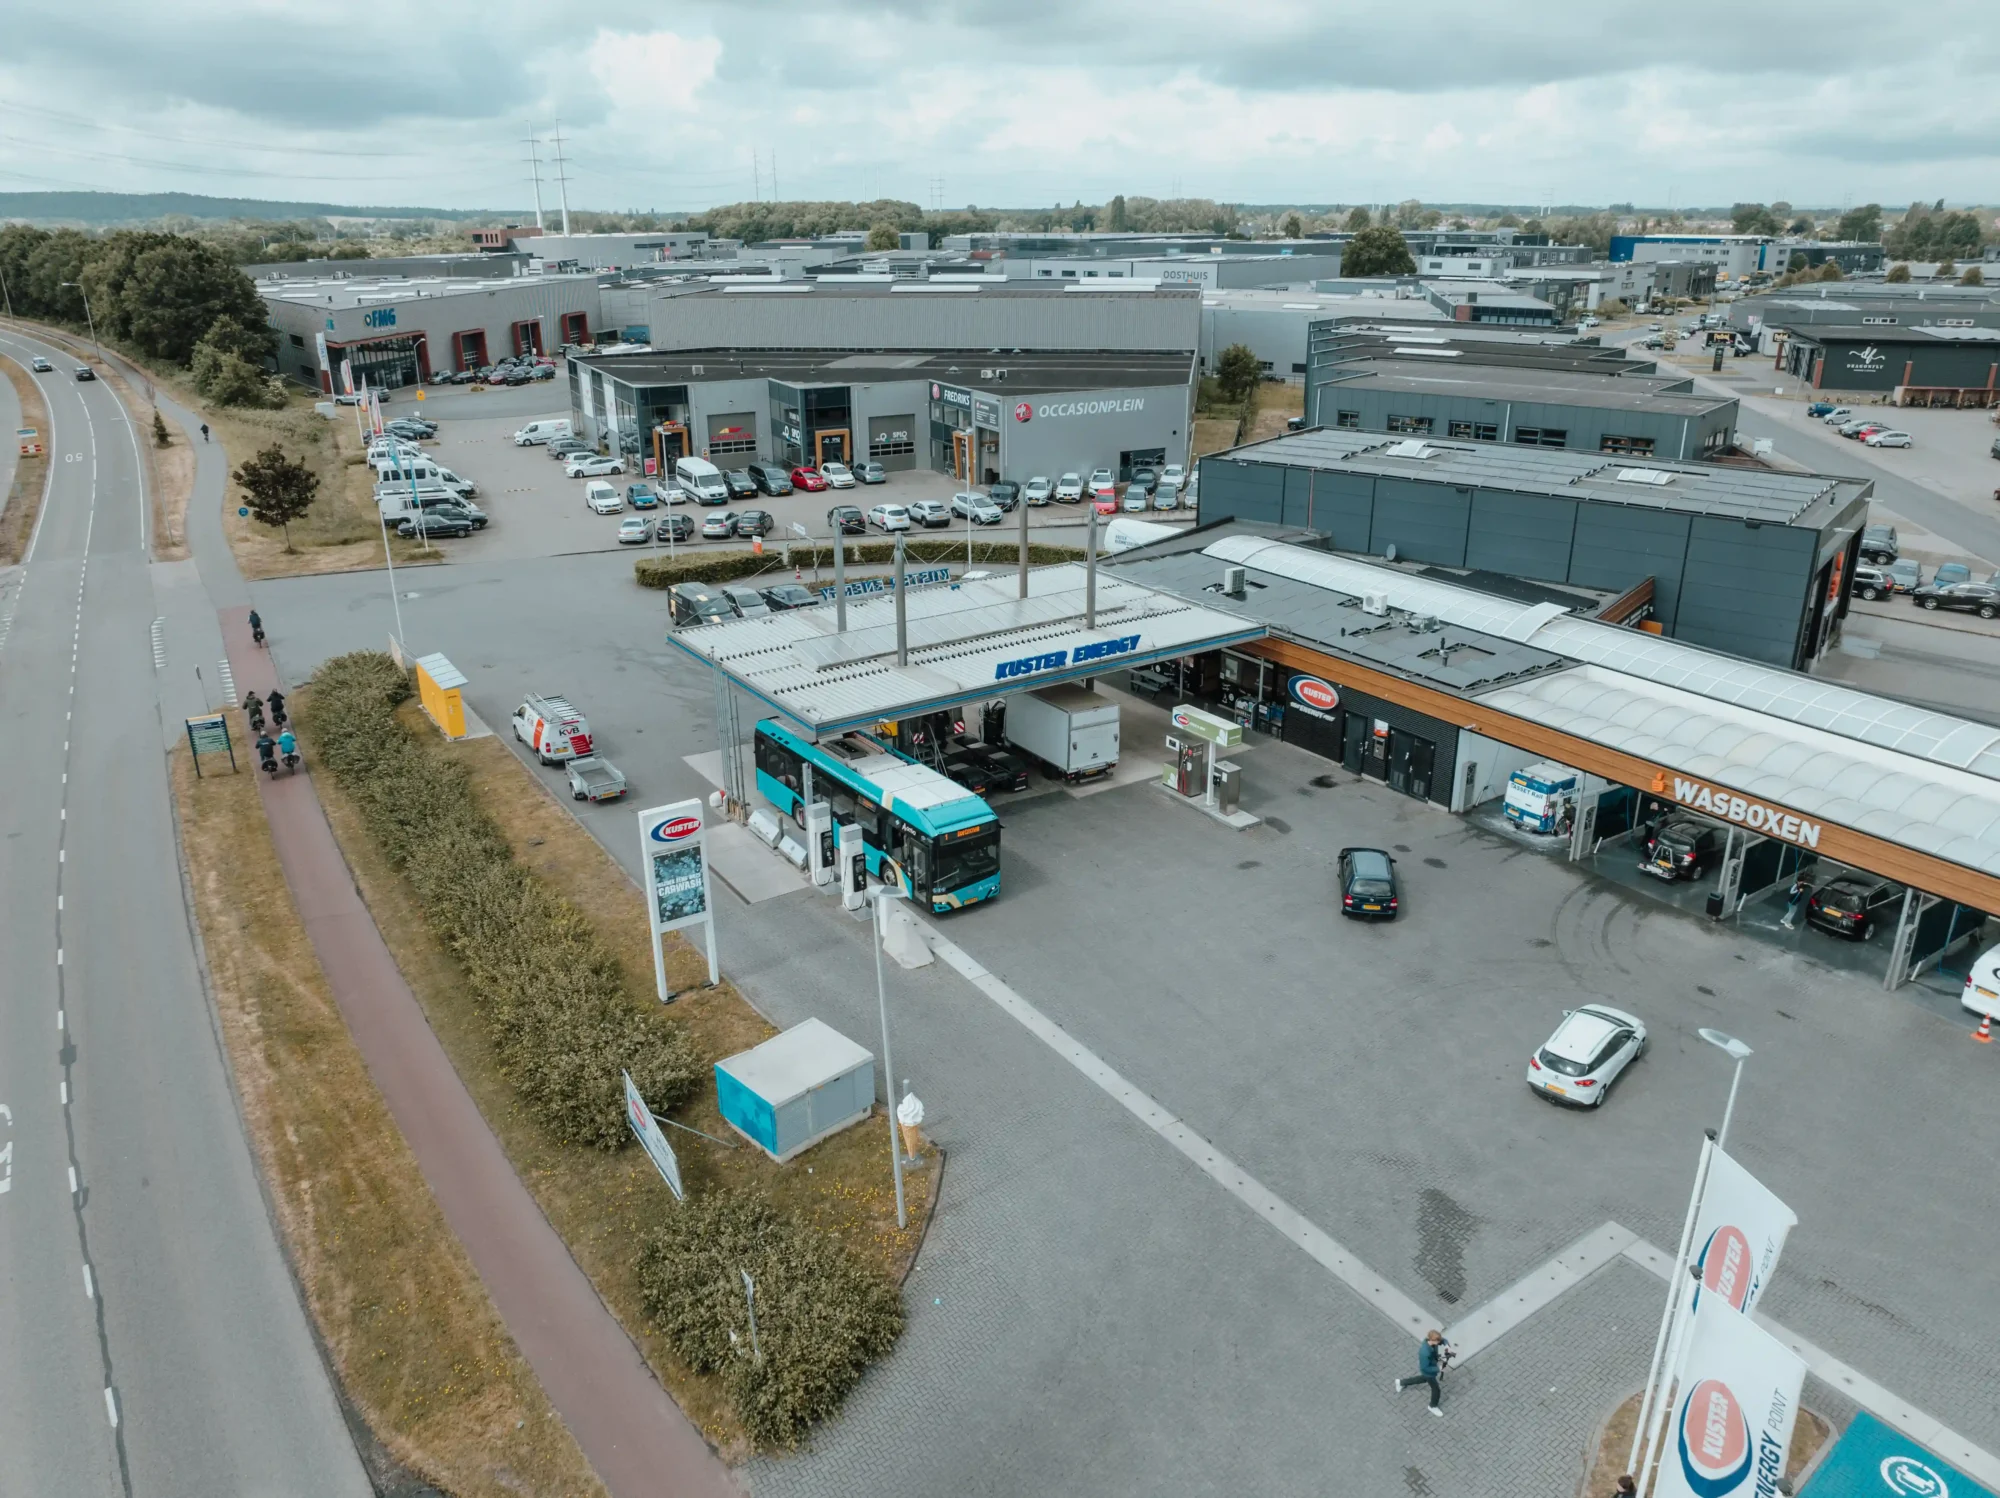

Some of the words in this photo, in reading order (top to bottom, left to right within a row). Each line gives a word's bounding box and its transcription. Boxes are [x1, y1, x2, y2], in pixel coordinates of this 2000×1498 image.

[1163, 270, 1209, 280] OOSTHUIS
[371, 308, 397, 328] FMG
[944, 389, 971, 406] FREDRIKS
[1039, 398, 1145, 418] OCCASIONPLEIN
[65, 452, 83, 463] 50
[995, 650, 1068, 680] KUSTER
[1072, 634, 1141, 664] ENERGY
[1303, 686, 1332, 703] KUSTER
[559, 726, 580, 737] KVB
[1674, 777, 1821, 848] WASBOXEN
[665, 820, 700, 835] KUSTER
[658, 877, 702, 897] CARWASH
[1767, 1387, 1789, 1432] POINT
[1702, 1391, 1728, 1460] KUSTER
